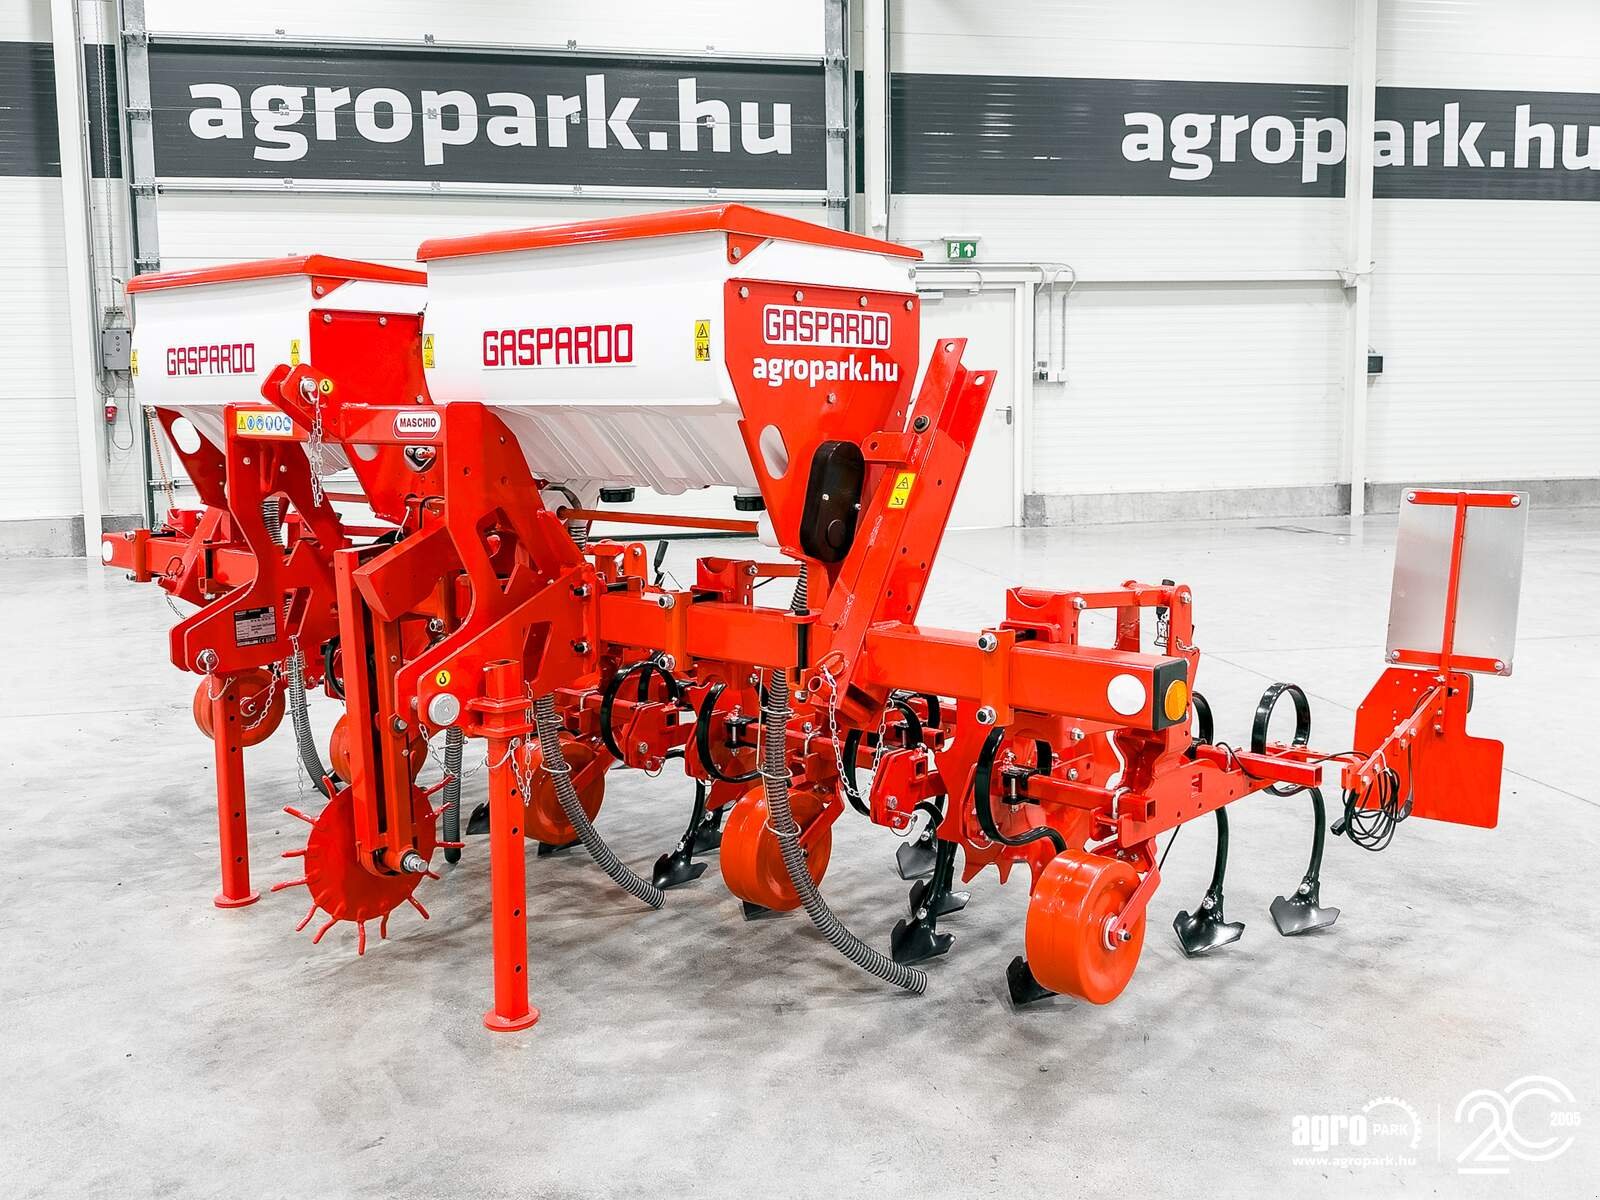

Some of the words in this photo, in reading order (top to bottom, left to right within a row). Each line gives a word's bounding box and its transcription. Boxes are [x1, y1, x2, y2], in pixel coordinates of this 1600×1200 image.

[188, 74, 792, 166] agropark.hu
[1121, 101, 1600, 183] agropark.hu
[483, 323, 634, 367] GASPARDO
[765, 308, 889, 346] GASPARDO
[166, 342, 256, 376] GASPARDO
[752, 353, 899, 388] agropark.hu
[400, 417, 436, 428] MASCHIO
